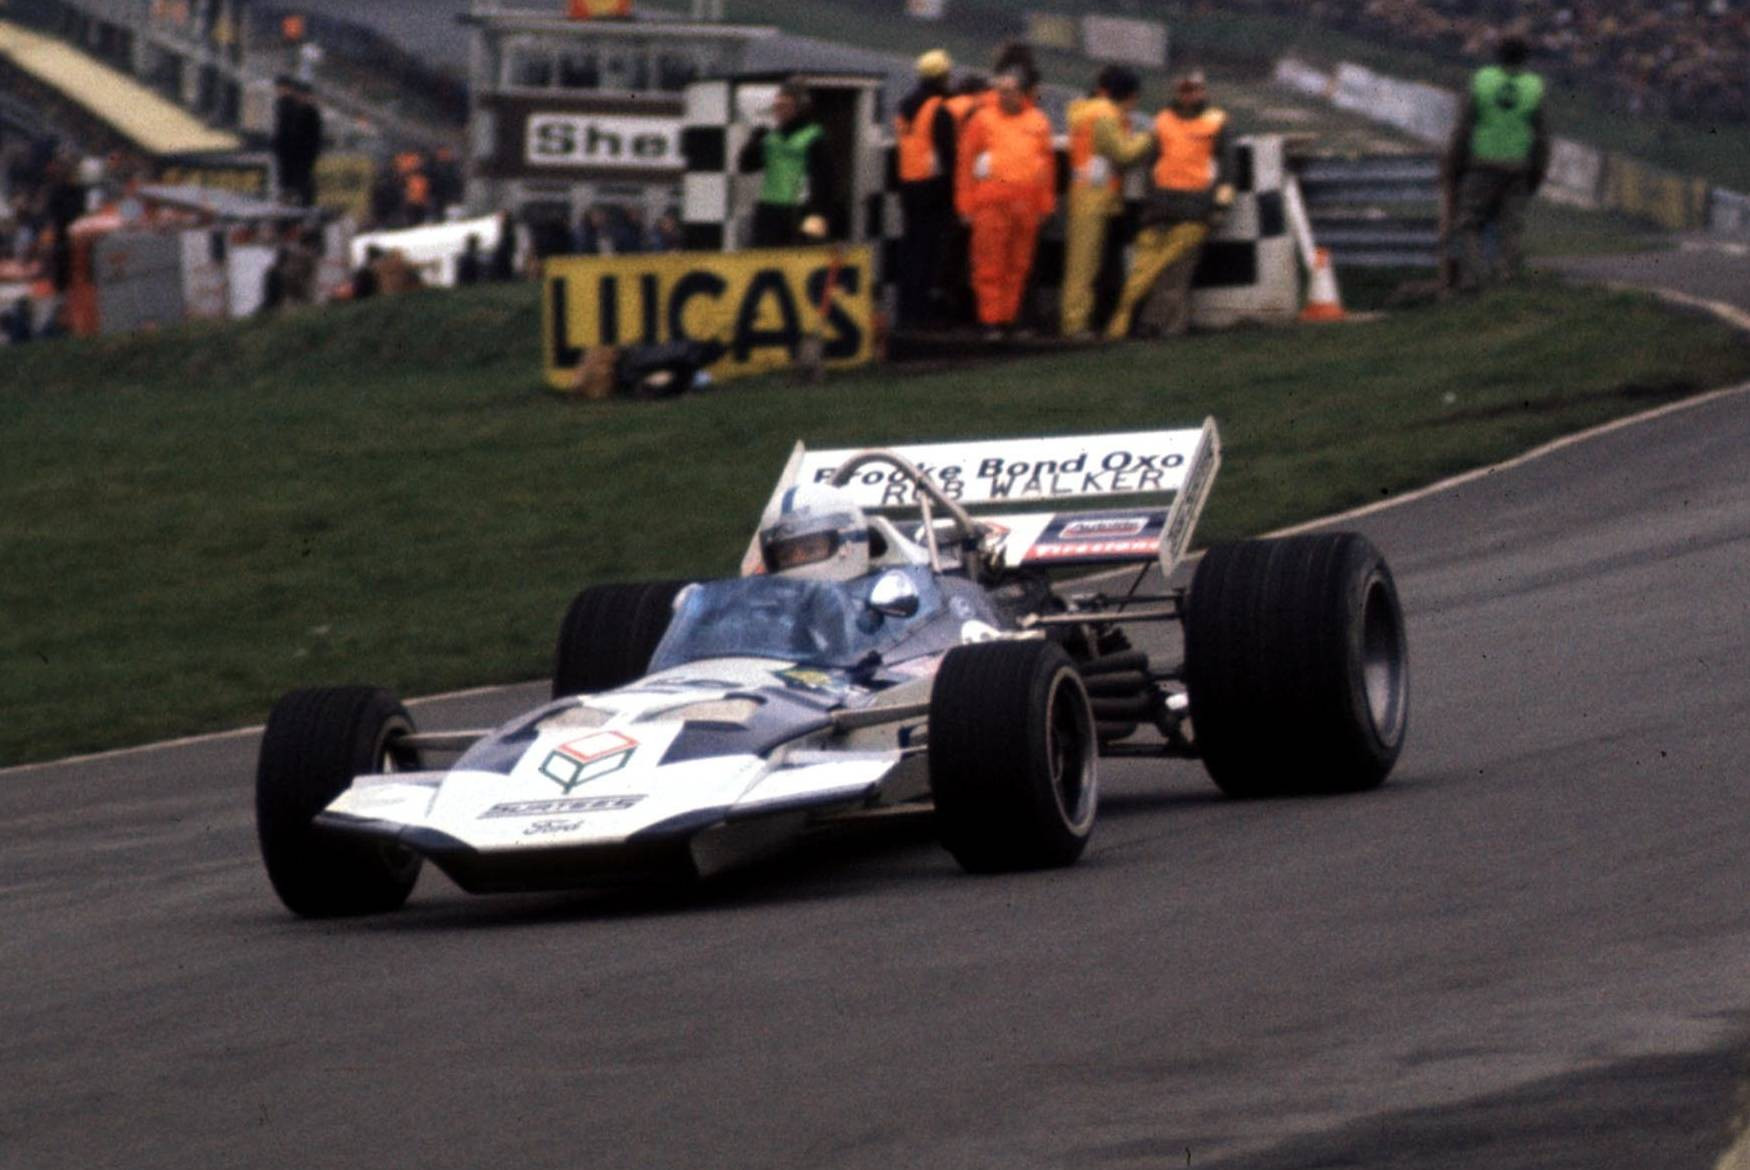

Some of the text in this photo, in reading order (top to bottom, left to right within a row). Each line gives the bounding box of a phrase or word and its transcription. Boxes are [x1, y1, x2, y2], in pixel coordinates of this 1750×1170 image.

[552, 267, 862, 368] LUCAS
[976, 452, 1088, 478] Bond
[1102, 451, 1184, 473] Oxo
[989, 469, 1165, 498] WALKER
[523, 819, 585, 836] Ford
